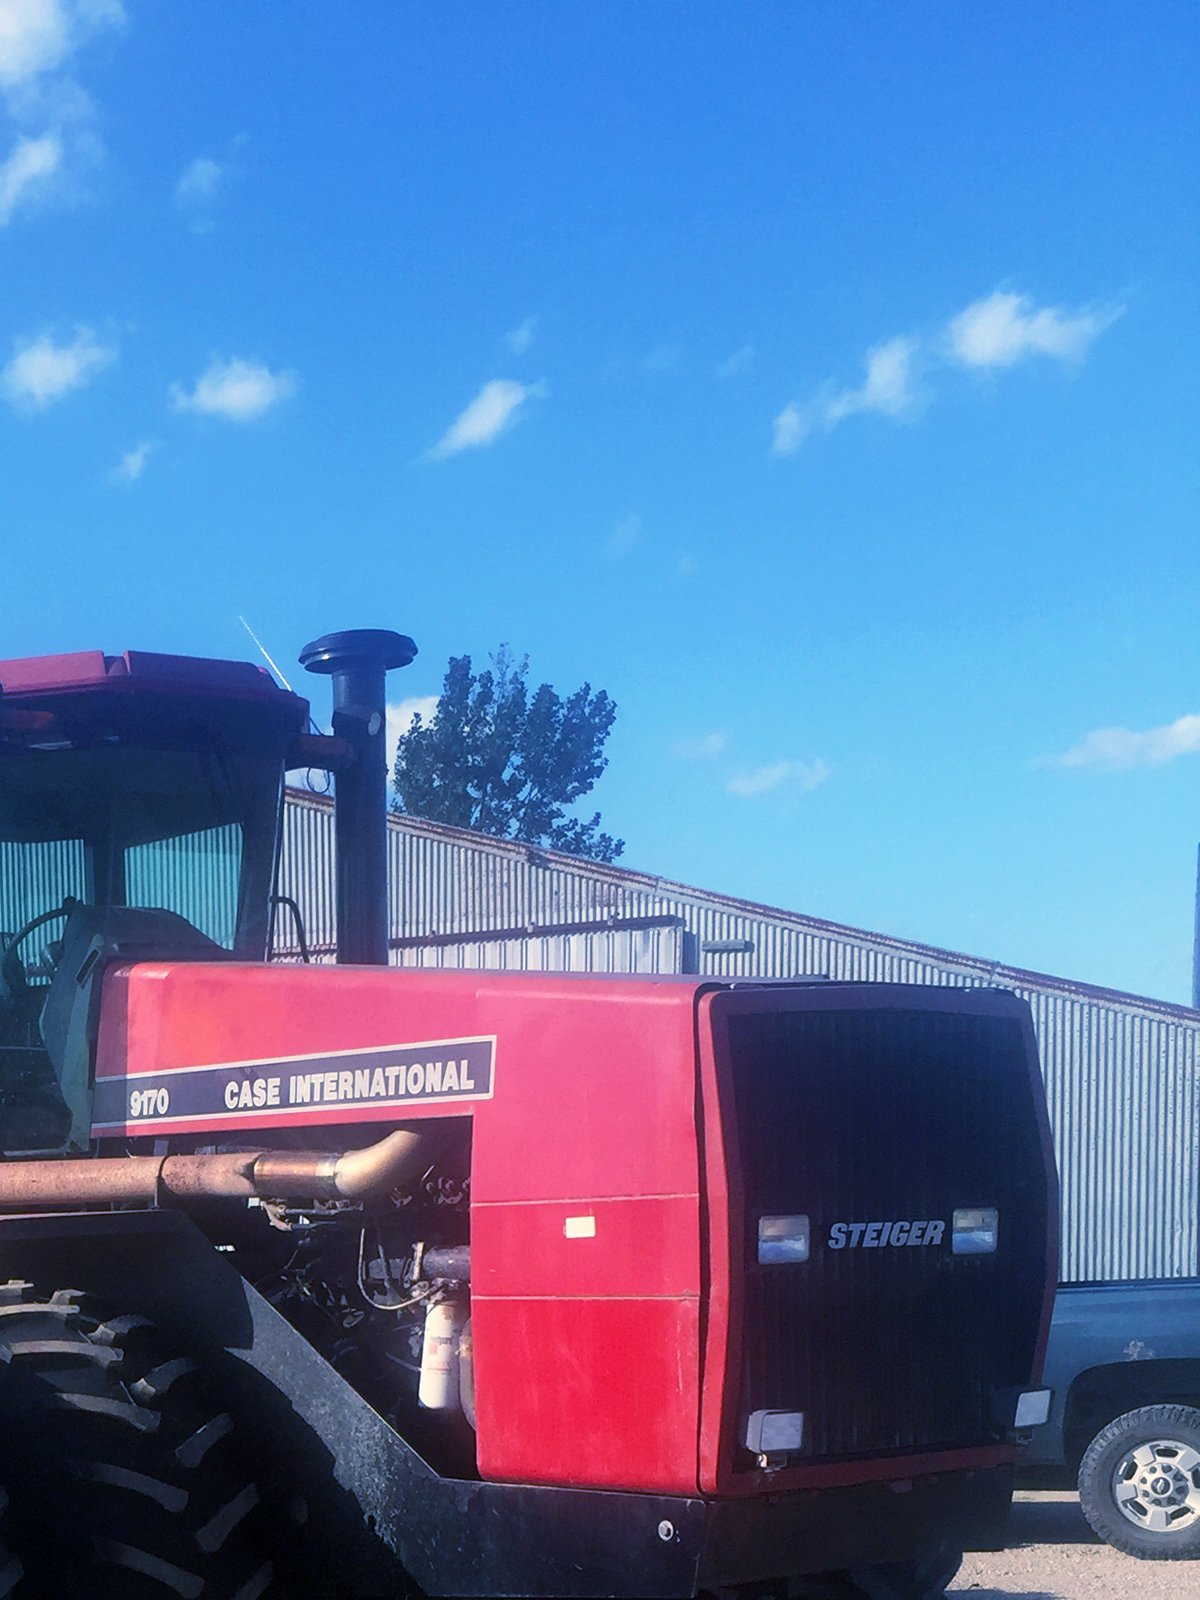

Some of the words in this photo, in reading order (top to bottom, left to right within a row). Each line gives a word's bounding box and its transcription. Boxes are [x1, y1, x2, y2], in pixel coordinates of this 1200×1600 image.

[130, 1087, 169, 1117] 9170
[224, 1077, 281, 1109] CASE
[289, 1059, 475, 1104] INTERNATIONAL
[827, 1220, 946, 1249] STEIGER
